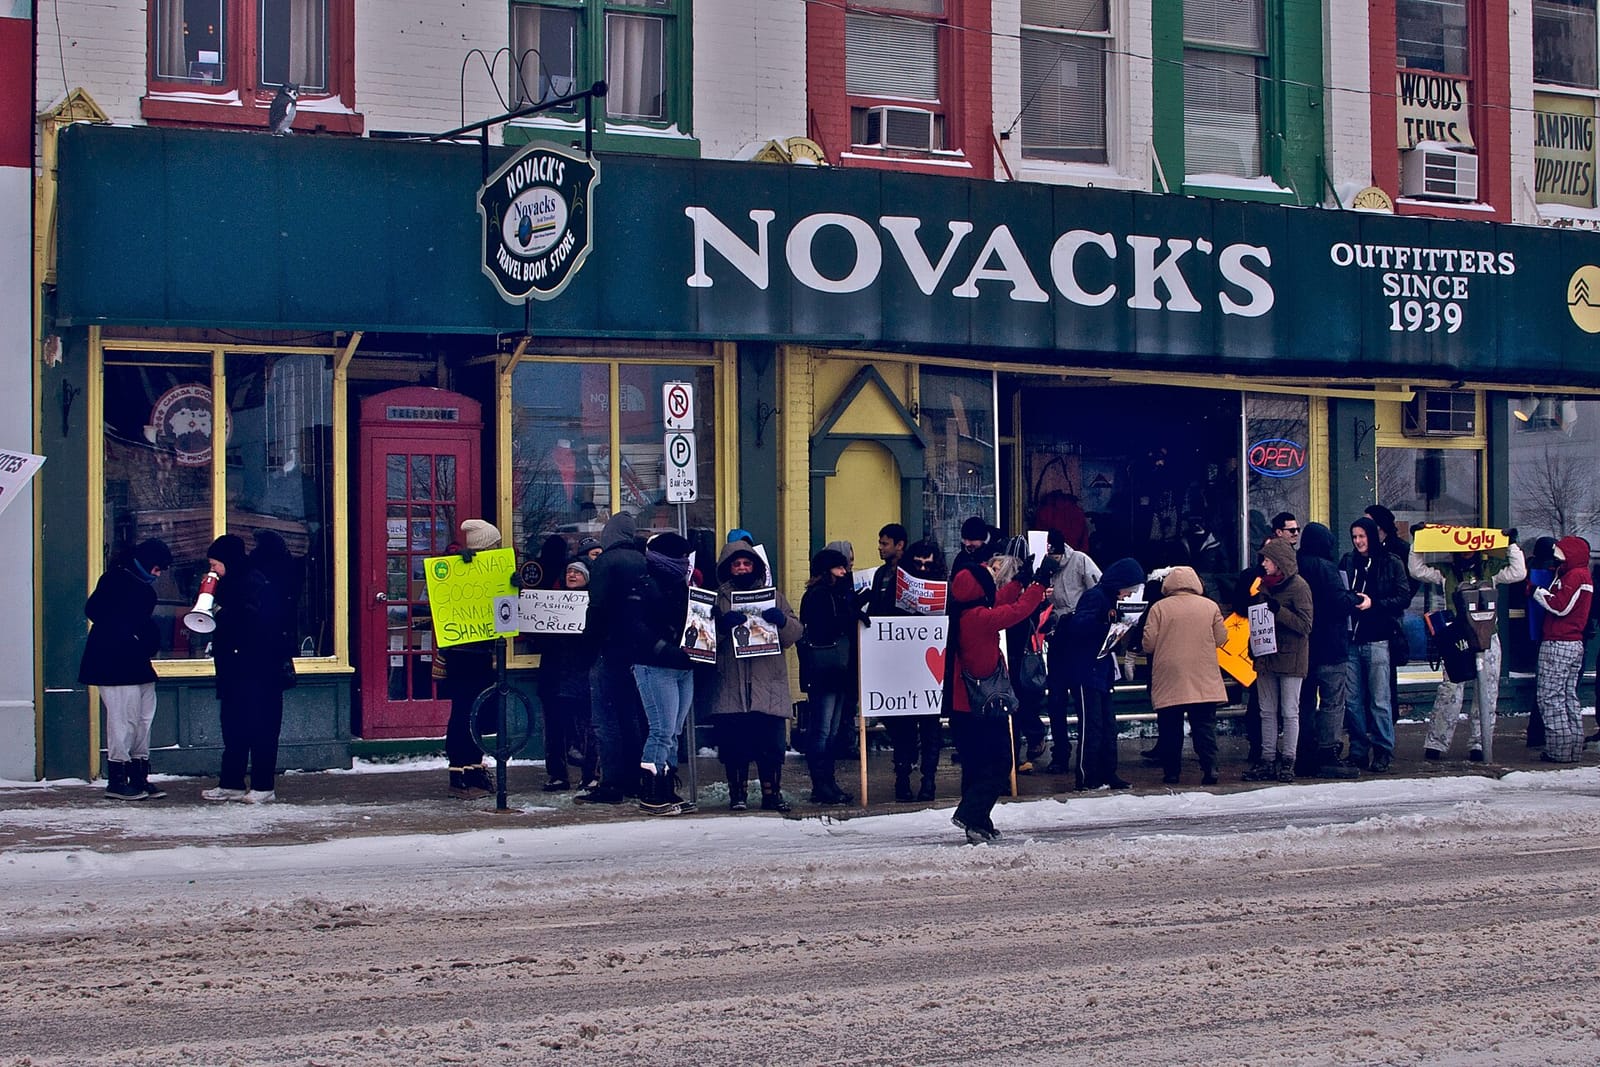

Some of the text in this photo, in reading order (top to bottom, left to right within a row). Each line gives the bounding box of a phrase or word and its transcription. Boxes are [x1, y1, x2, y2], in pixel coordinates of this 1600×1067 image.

[1400, 73, 1462, 111] WOODS
[506, 156, 566, 198] NOVACK'S
[1535, 158, 1591, 196] UPPLIES
[514, 195, 556, 221] Novacks
[496, 228, 576, 282] TRAVEL BOOK STORE
[684, 206, 1275, 318] NOVACK'S
[1330, 243, 1516, 275] OUTFITTERS
[1382, 272, 1469, 300] SINCE
[1389, 300, 1463, 334] 1939
[676, 442, 686, 459] P
[1250, 446, 1306, 467] OPEN
[1453, 530, 1496, 550] Ugly
[453, 555, 514, 577] CANADA
[433, 582, 493, 605] GOOSE
[559, 592, 588, 602] NOT
[437, 603, 494, 622] CANADA
[534, 602, 576, 611] FASHION
[1251, 607, 1270, 627] FUR
[534, 620, 586, 632] CRUEL
[548, 615, 560, 623] IS
[877, 622, 943, 641] Have a
[869, 691, 918, 711] Don't
